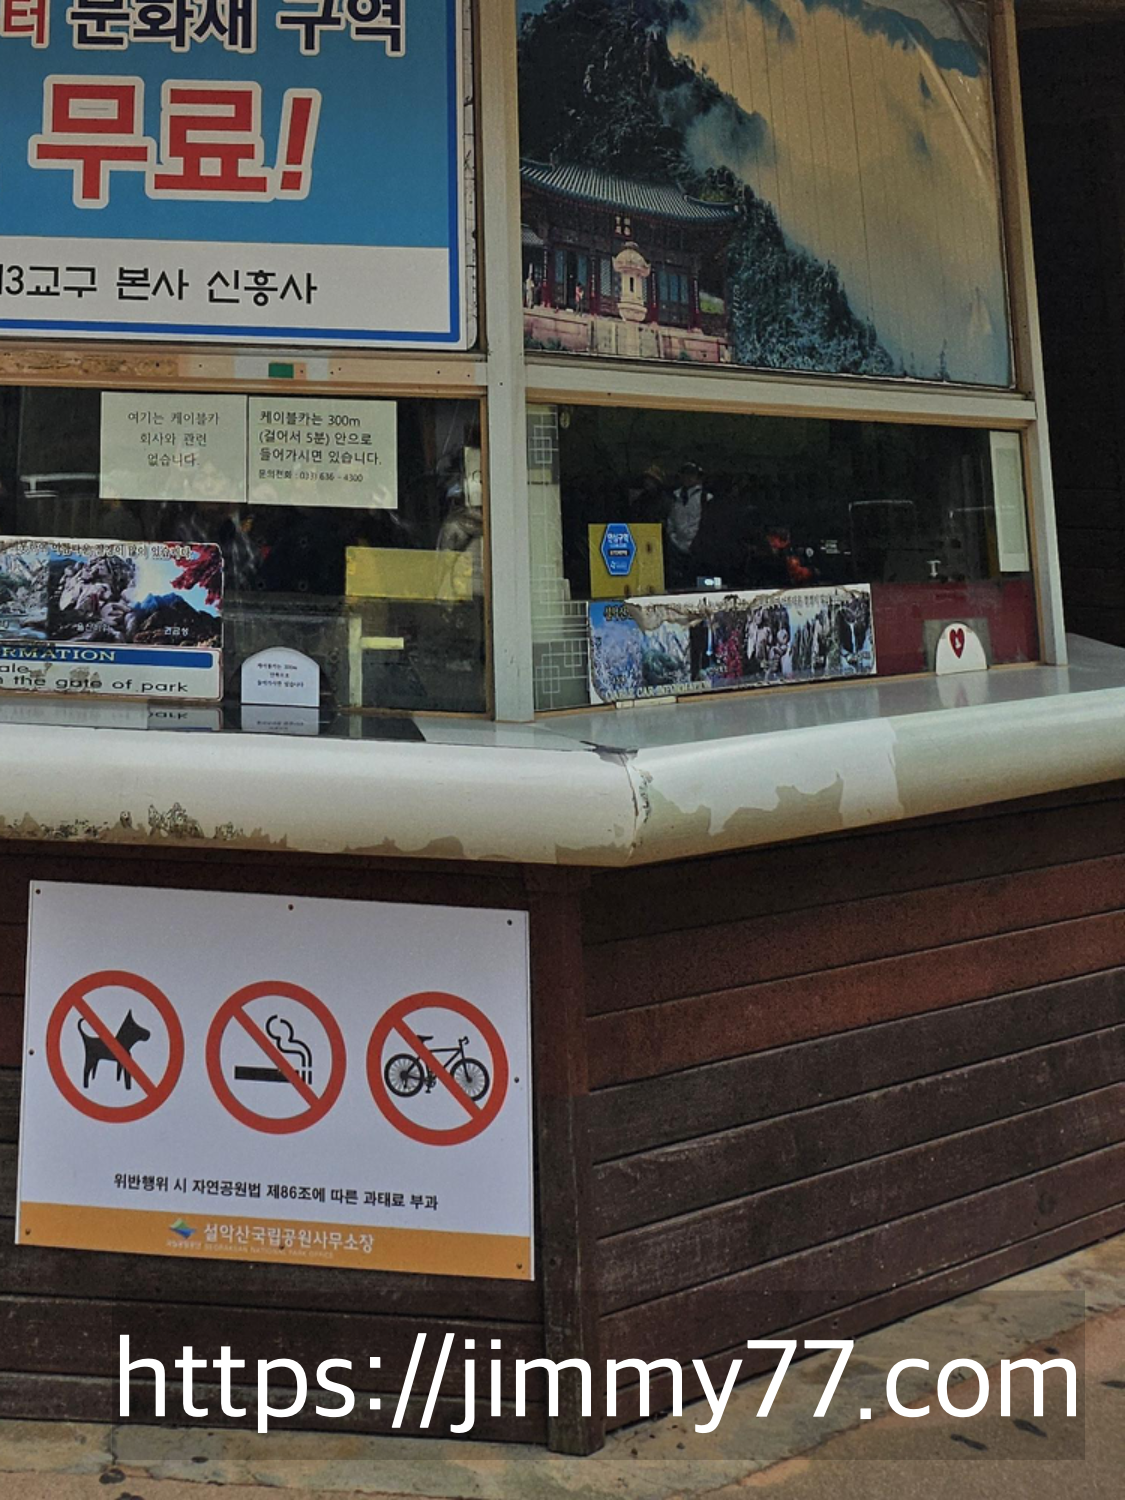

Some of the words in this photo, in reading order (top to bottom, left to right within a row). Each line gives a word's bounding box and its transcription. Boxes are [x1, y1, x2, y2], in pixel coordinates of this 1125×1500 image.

[36, 79, 315, 202] 무료!
[117, 267, 188, 303] 본사
[206, 269, 317, 307] 신흥사
[128, 411, 164, 425] 여기는
[171, 412, 219, 425] 케이블카
[260, 411, 323, 425] 케이블카는
[328, 415, 360, 426] 300m
[140, 432, 176, 445] 회사와
[184, 433, 207, 447] 관련
[259, 430, 301, 443] (걸어서
[306, 432, 330, 446] 5분)
[334, 432, 372, 445] 안으로
[147, 453, 200, 467] 없습니다.
[259, 448, 322, 463] 들어가시면
[328, 451, 382, 465] 있습니다.
[259, 469, 292, 479] 문의전화
[319, 472, 335, 481] 636
[14, 675, 46, 686] the
[55, 677, 103, 690] gate
[111, 678, 134, 690] of
[141, 680, 189, 694] park
[114, 1172, 169, 1192] 위반행위
[174, 1177, 187, 1193] 시
[192, 1179, 261, 1198] 자연공원법
[266, 1183, 325, 1202] 제86조에
[330, 1189, 358, 1205] 따른
[363, 1190, 405, 1208] 과태료
[410, 1194, 438, 1210] 부과
[204, 1223, 374, 1254] 설악산국립공원사무소장
